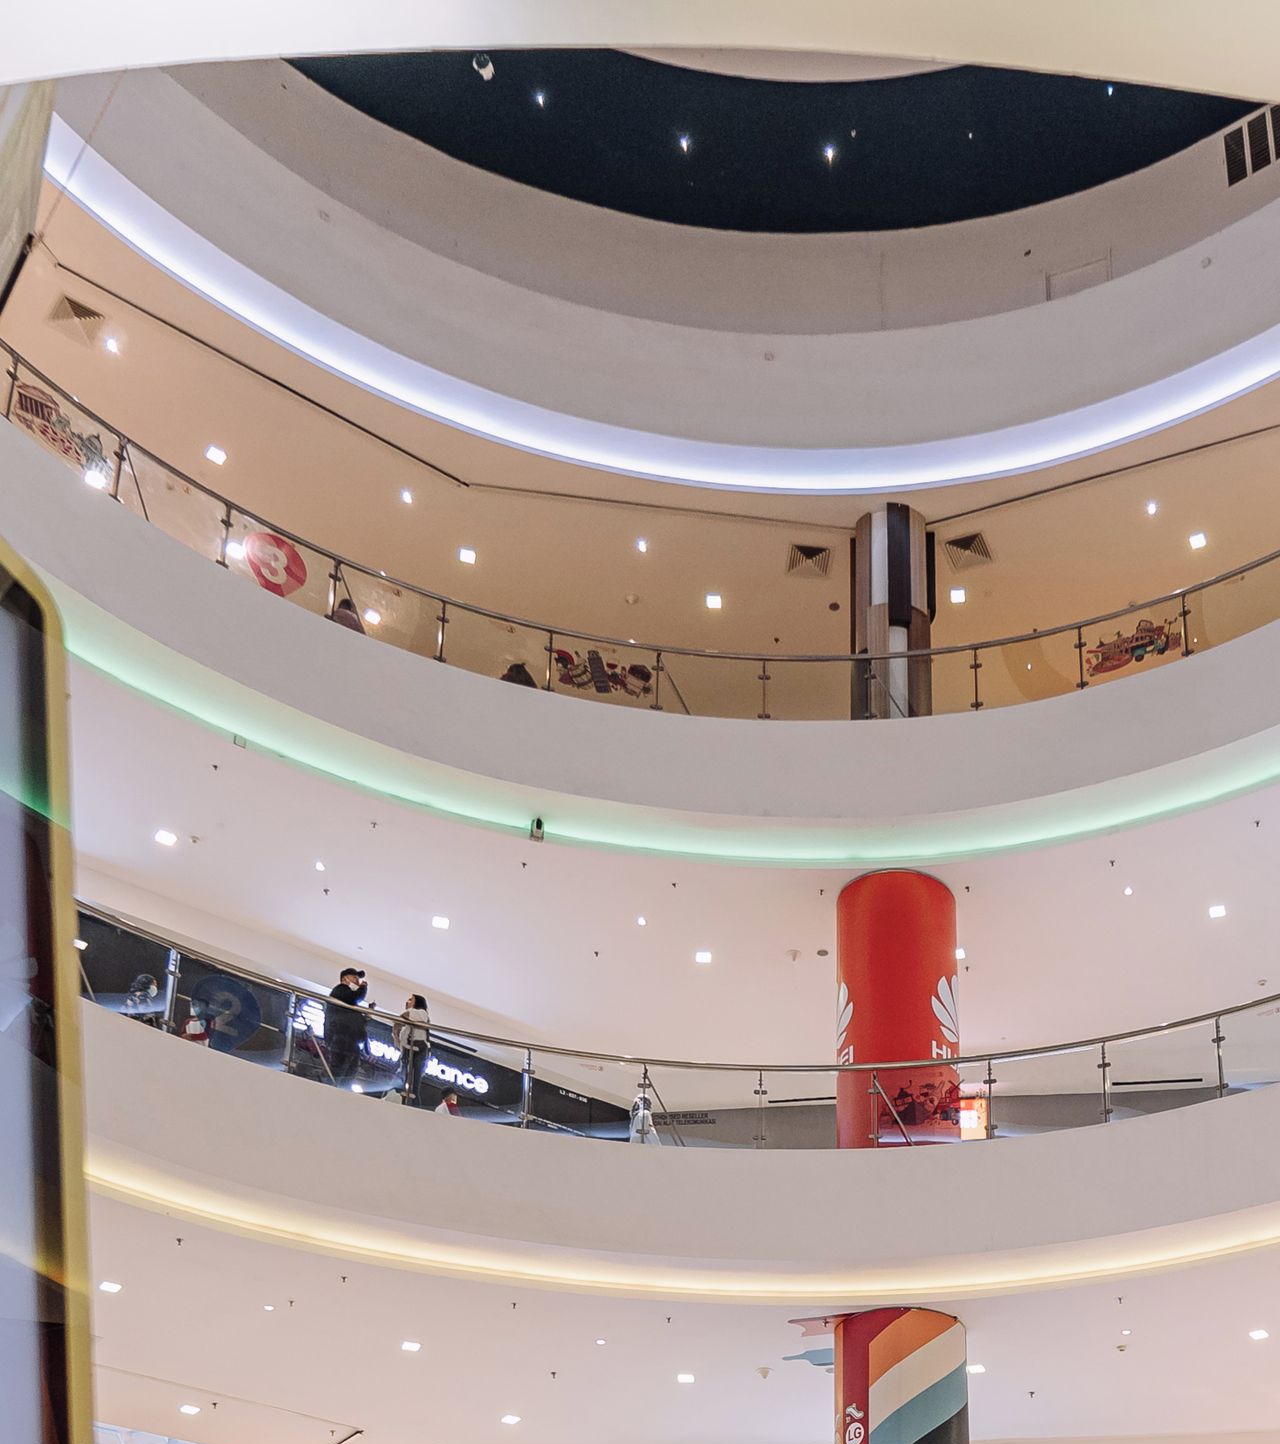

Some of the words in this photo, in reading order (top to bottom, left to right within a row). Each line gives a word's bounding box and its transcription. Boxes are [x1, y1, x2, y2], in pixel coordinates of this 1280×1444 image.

[256, 541, 289, 587] 3
[359, 1037, 402, 1062] ew
[425, 1057, 489, 1094] lance
[848, 1427, 862, 1443] LG
